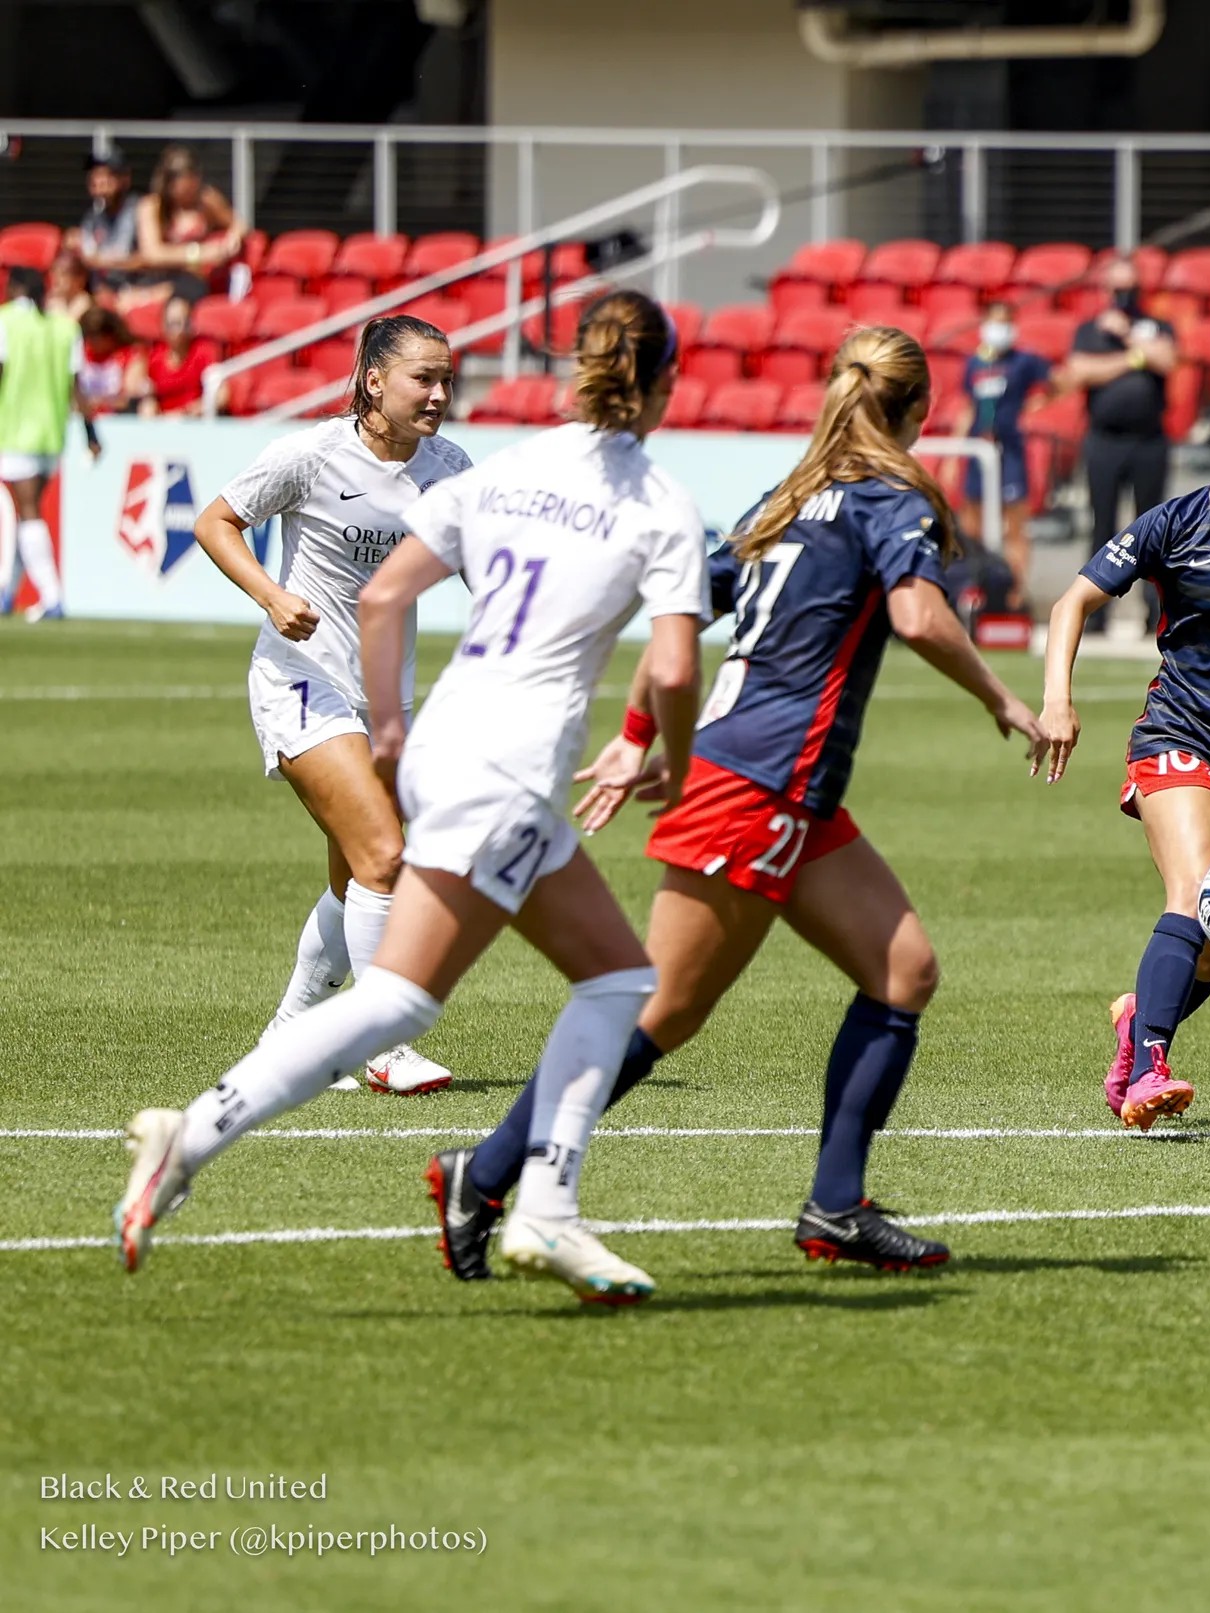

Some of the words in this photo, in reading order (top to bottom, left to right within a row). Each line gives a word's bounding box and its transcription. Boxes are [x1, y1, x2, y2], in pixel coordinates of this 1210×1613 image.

[461, 546, 549, 658] 21
[289, 679, 309, 731] 7
[496, 826, 550, 895] 21
